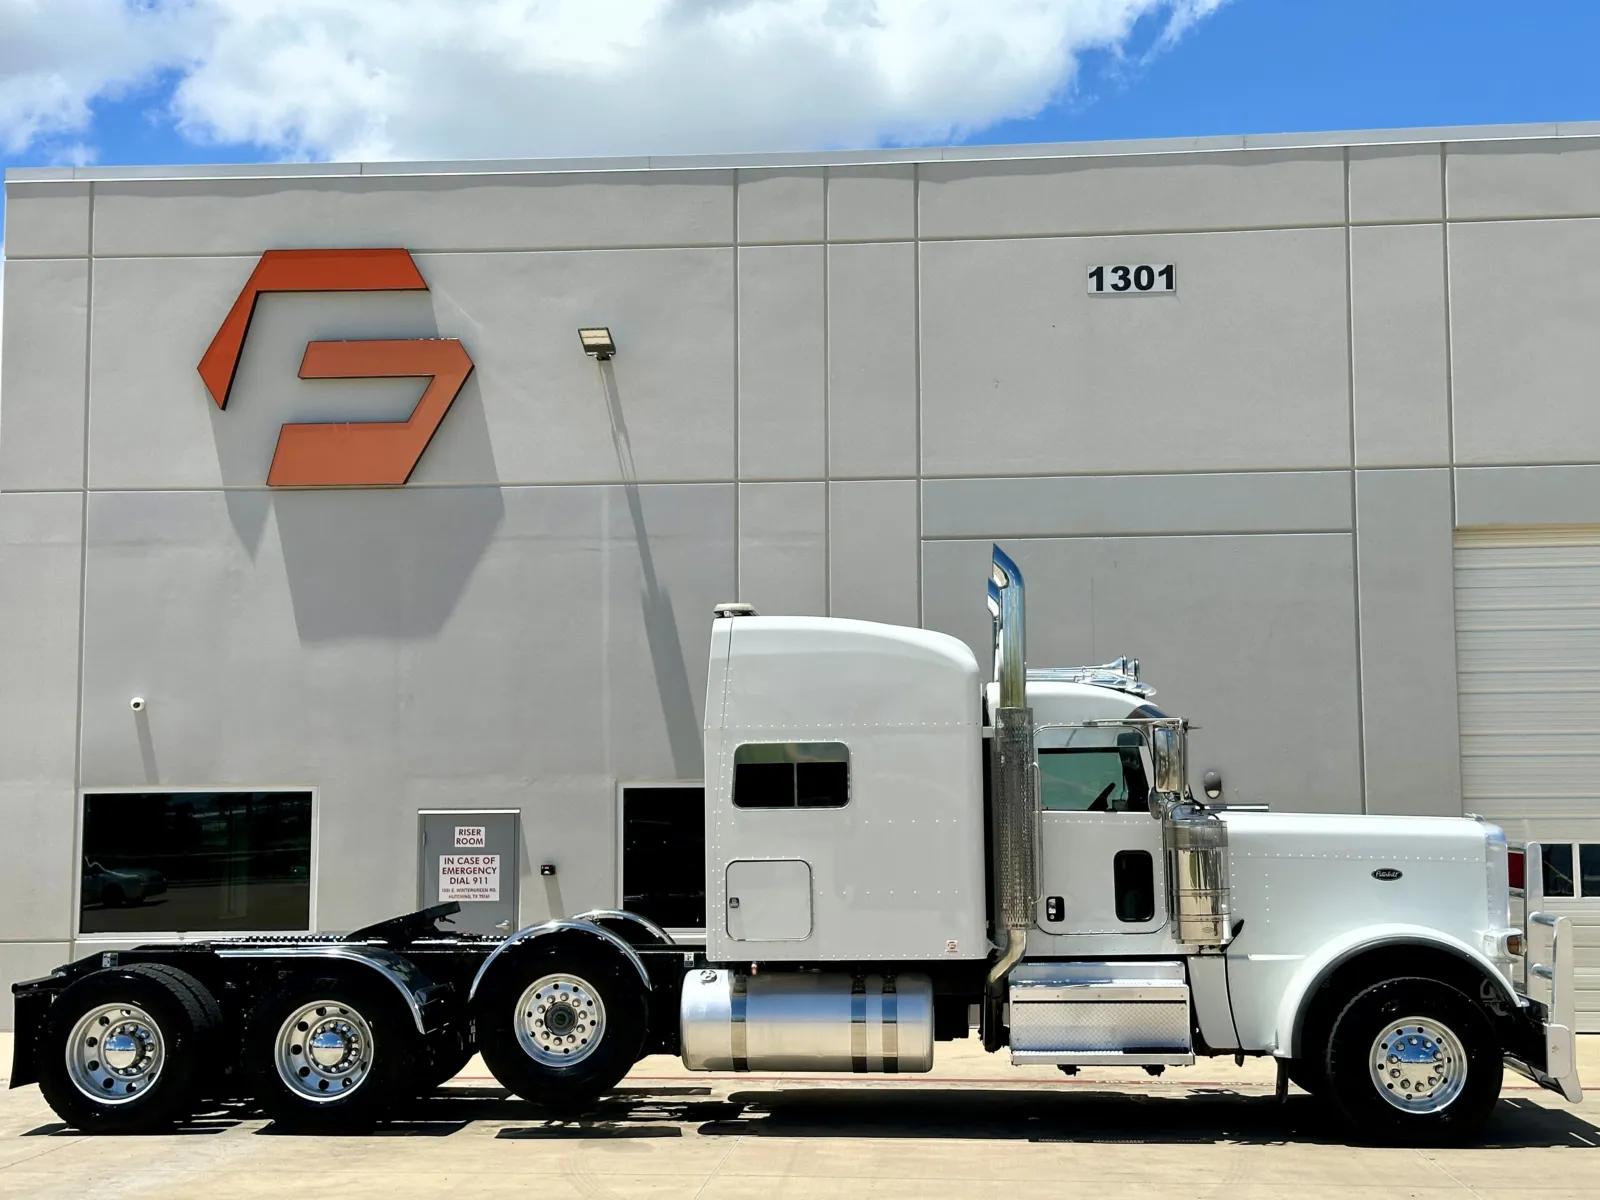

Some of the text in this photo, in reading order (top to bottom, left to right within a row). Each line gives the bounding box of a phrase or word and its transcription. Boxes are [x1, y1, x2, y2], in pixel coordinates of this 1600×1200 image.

[1088, 264, 1174, 292] 1301
[458, 828, 482, 836] RISER
[456, 837, 484, 845] ROOM
[444, 856, 496, 865] IN CASE OF
[442, 867, 497, 875] EMERGENCY
[449, 876, 488, 885] DIAL 911
